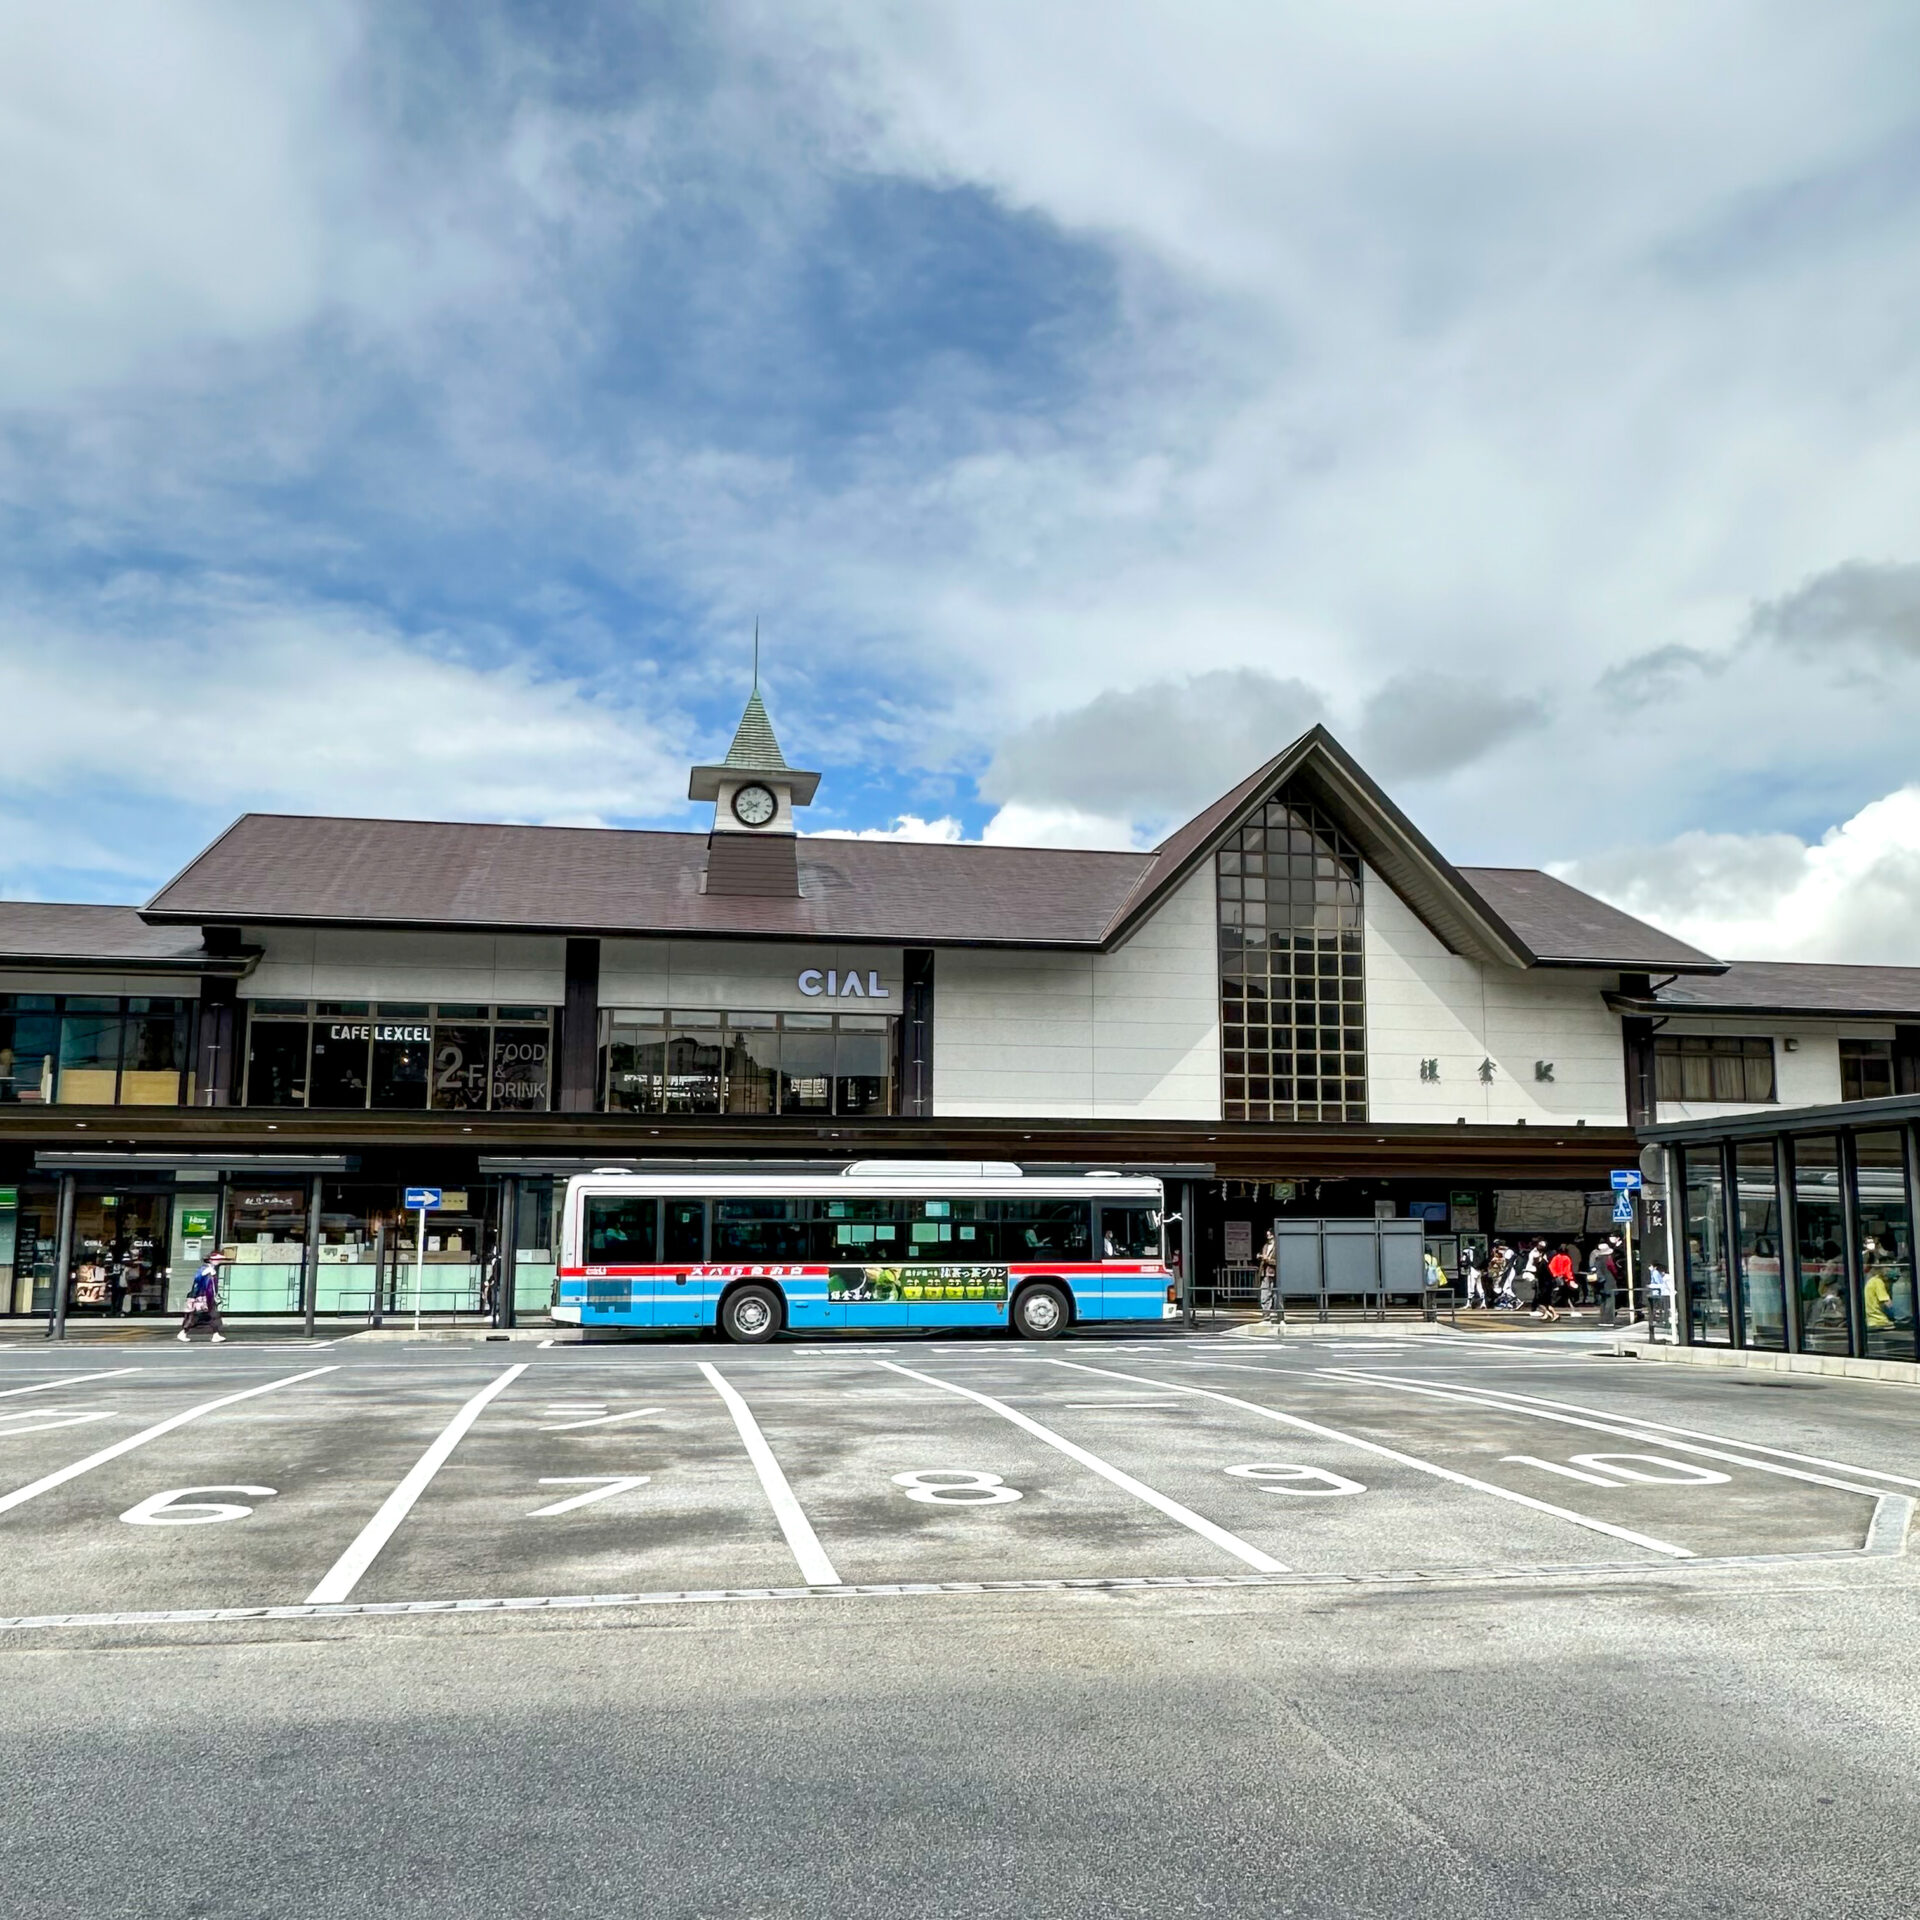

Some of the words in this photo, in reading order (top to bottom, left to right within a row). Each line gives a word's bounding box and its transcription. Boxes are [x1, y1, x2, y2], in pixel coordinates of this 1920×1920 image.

[799, 969, 889, 998] CIAL
[331, 1025, 370, 1040] CAFE
[374, 1026, 431, 1041] LEXCEL
[494, 1043, 546, 1061] FOOD
[495, 1064, 504, 1078] &
[493, 1081, 546, 1099] DRINK
[118, 1485, 278, 1526] 6
[526, 1476, 651, 1517] 7
[891, 1469, 1023, 1506] 8
[1224, 1463, 1368, 1497] 9
[1499, 1453, 1732, 1487] 10
